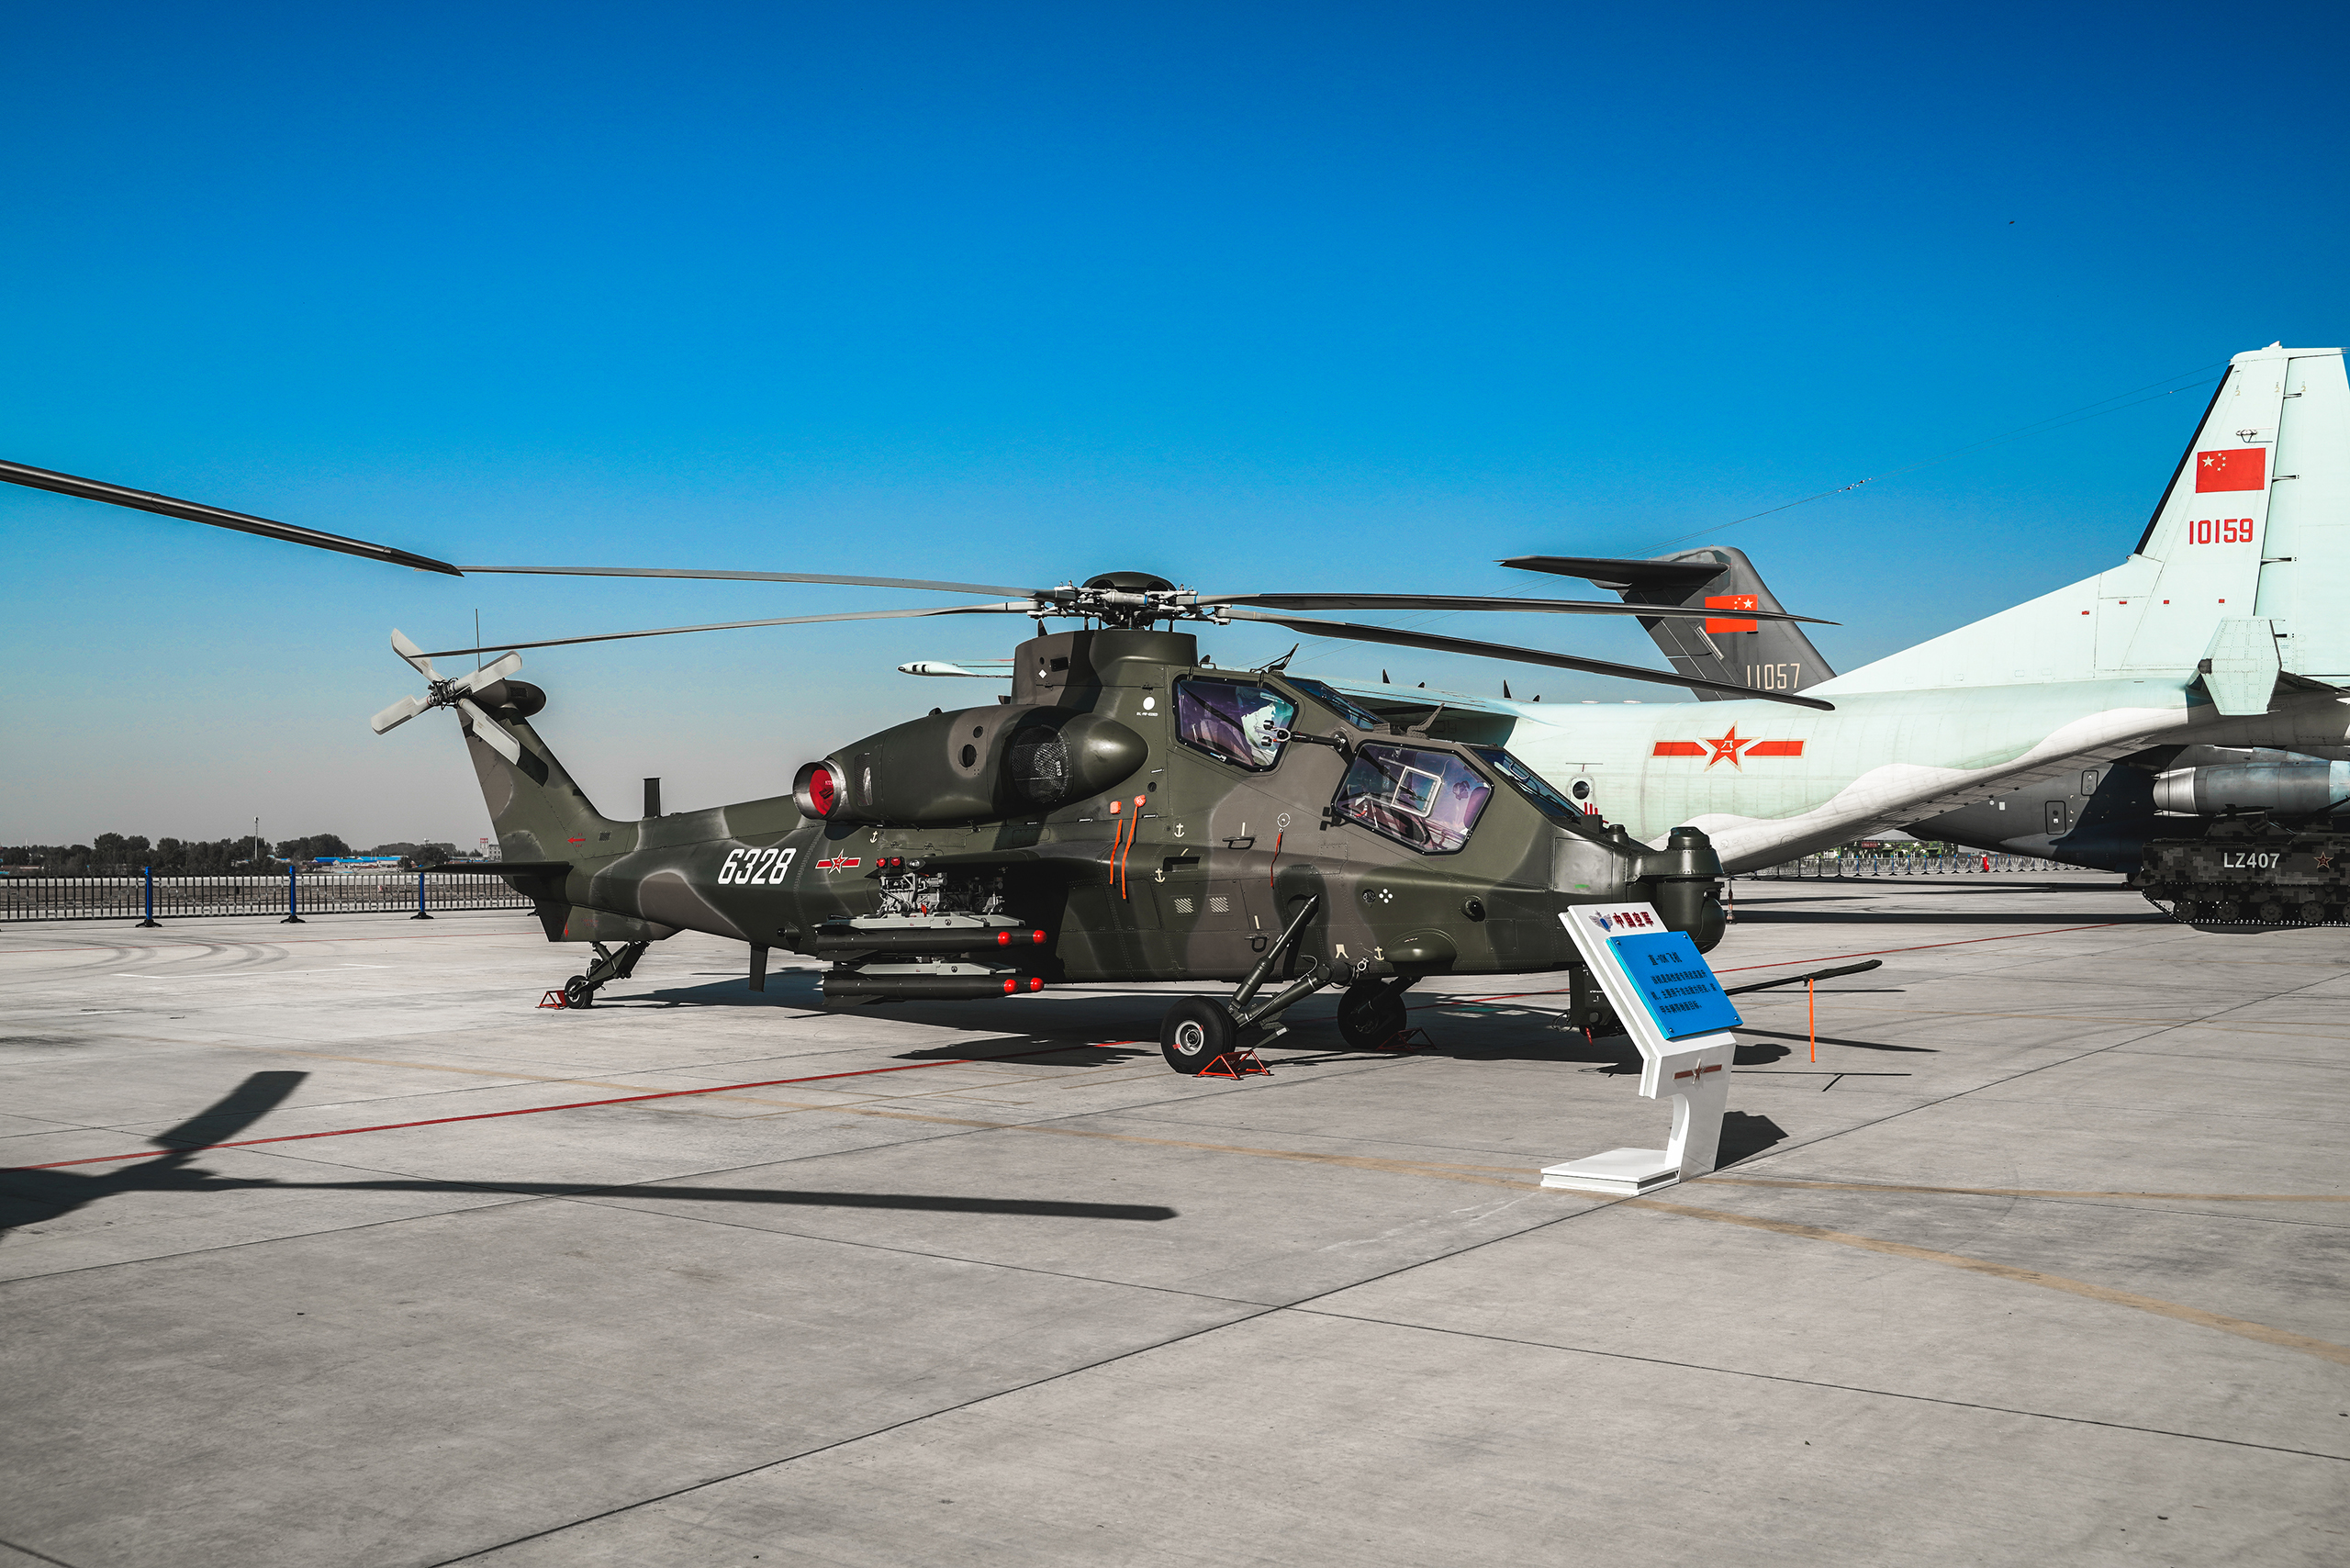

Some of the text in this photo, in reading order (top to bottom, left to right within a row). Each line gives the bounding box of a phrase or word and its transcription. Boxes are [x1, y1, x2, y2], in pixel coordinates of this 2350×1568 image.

[2189, 518, 2254, 544] 10159
[1747, 663, 1800, 689] 11057
[718, 848, 796, 884] 6328
[2223, 852, 2280, 868] LZ407
[1613, 912, 1654, 927] 中国空军
